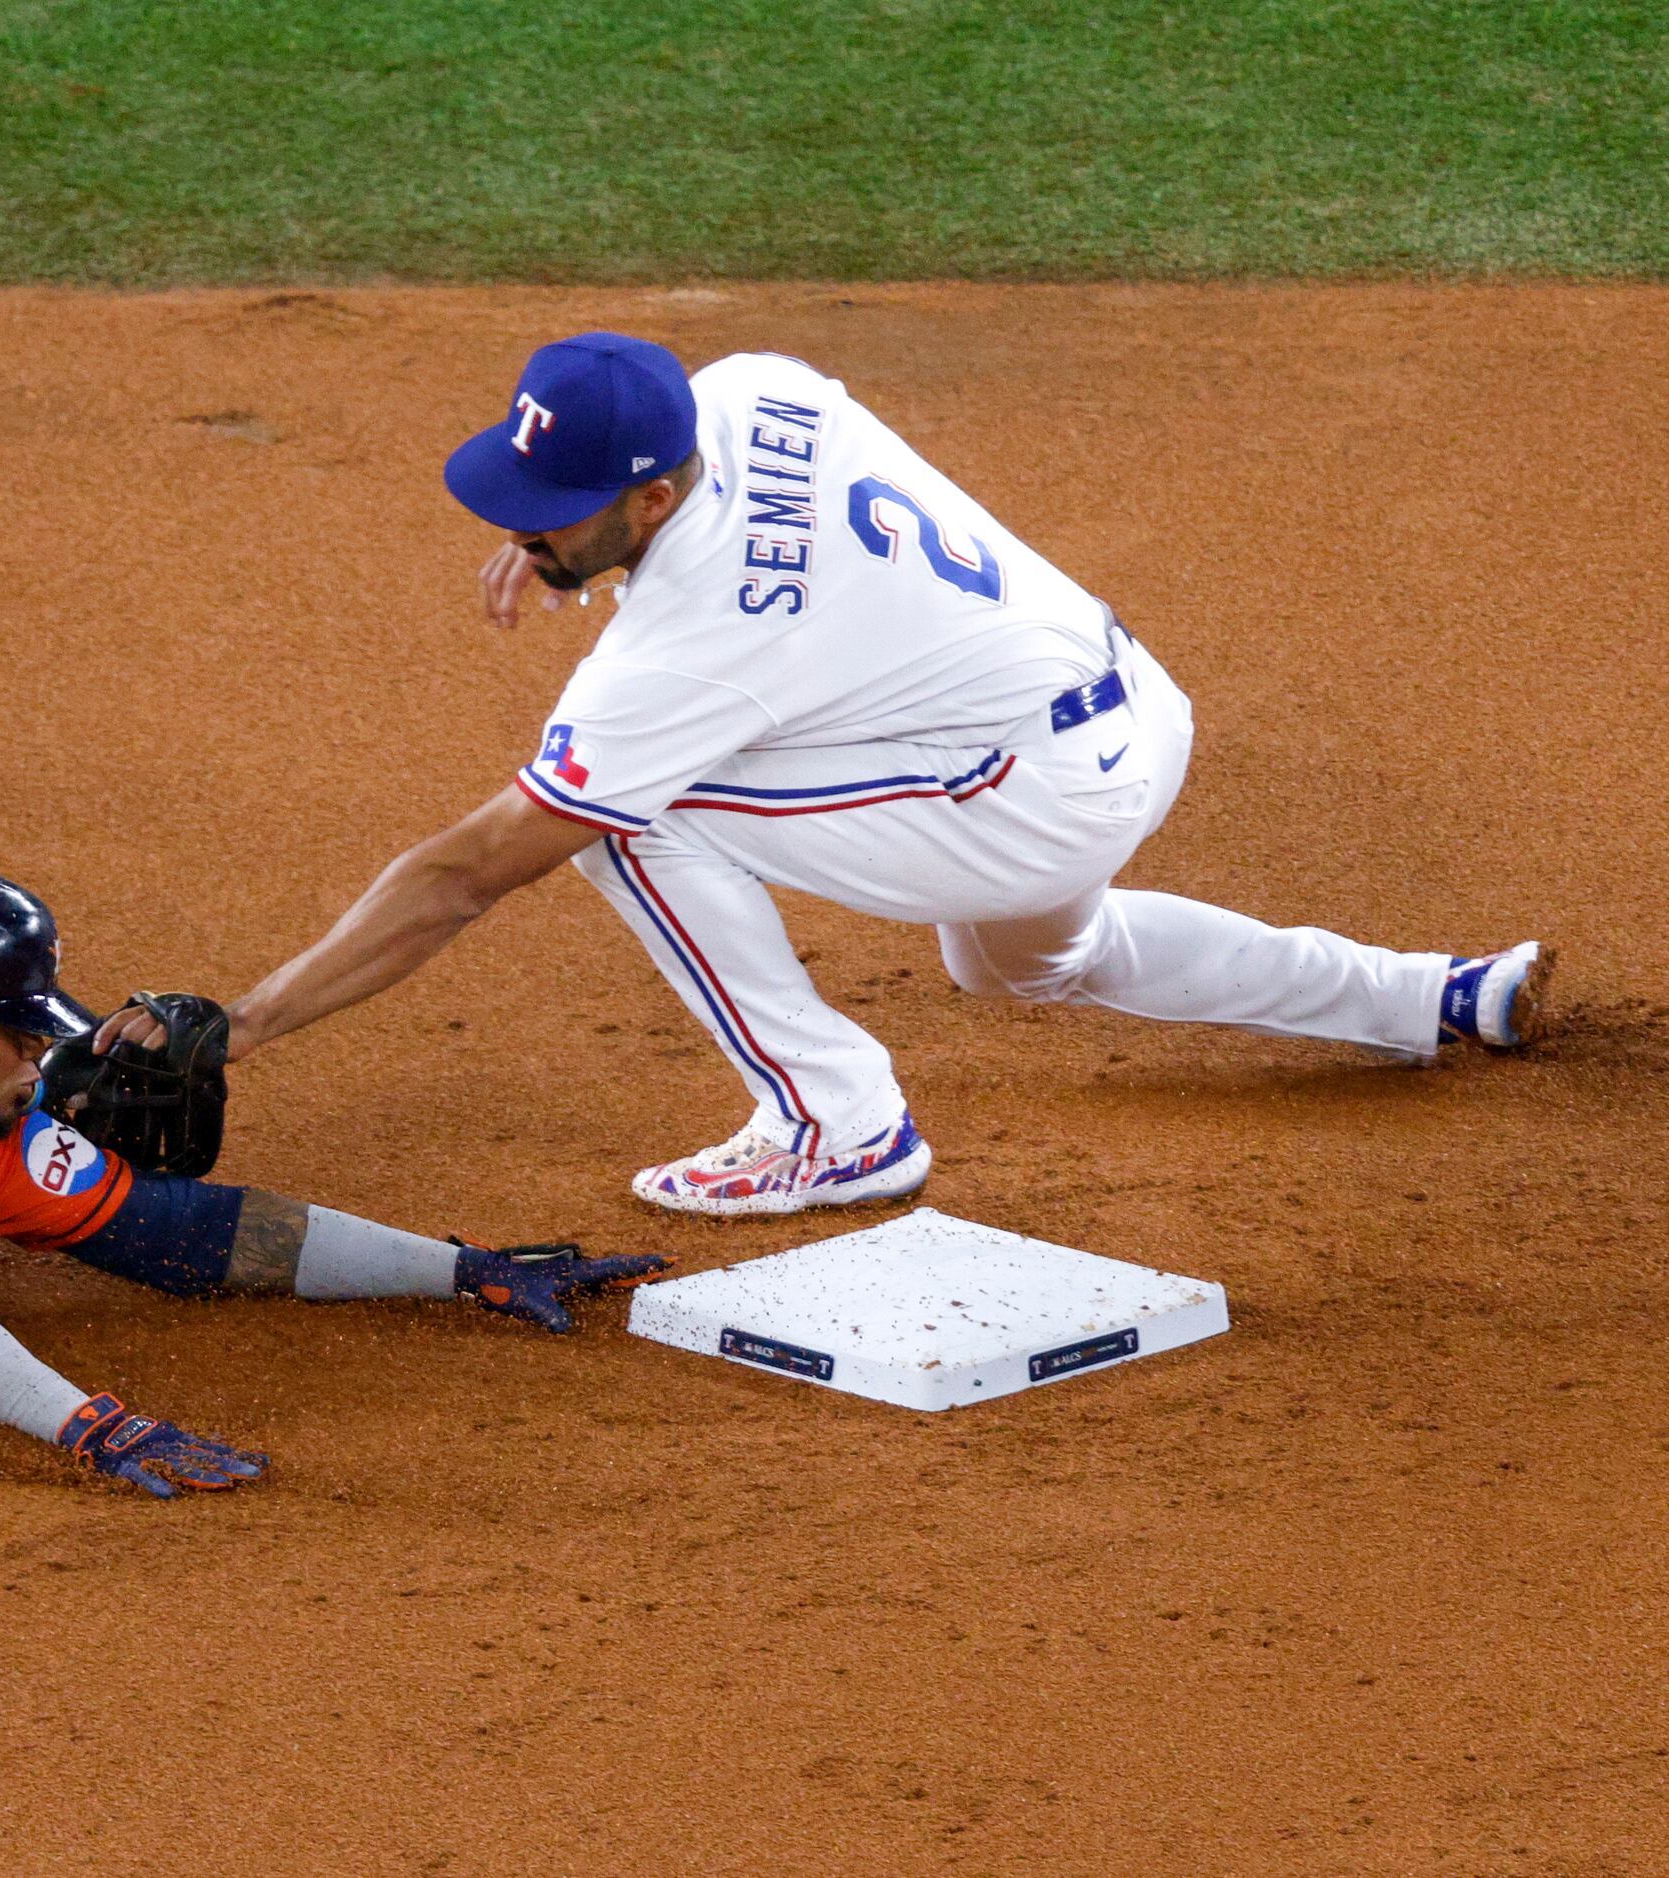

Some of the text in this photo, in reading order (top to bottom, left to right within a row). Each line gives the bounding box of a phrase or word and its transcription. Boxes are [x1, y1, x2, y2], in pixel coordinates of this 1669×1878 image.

[511, 392, 556, 457] T
[738, 395, 824, 615] SEMIEN
[846, 471, 1008, 608] 2
